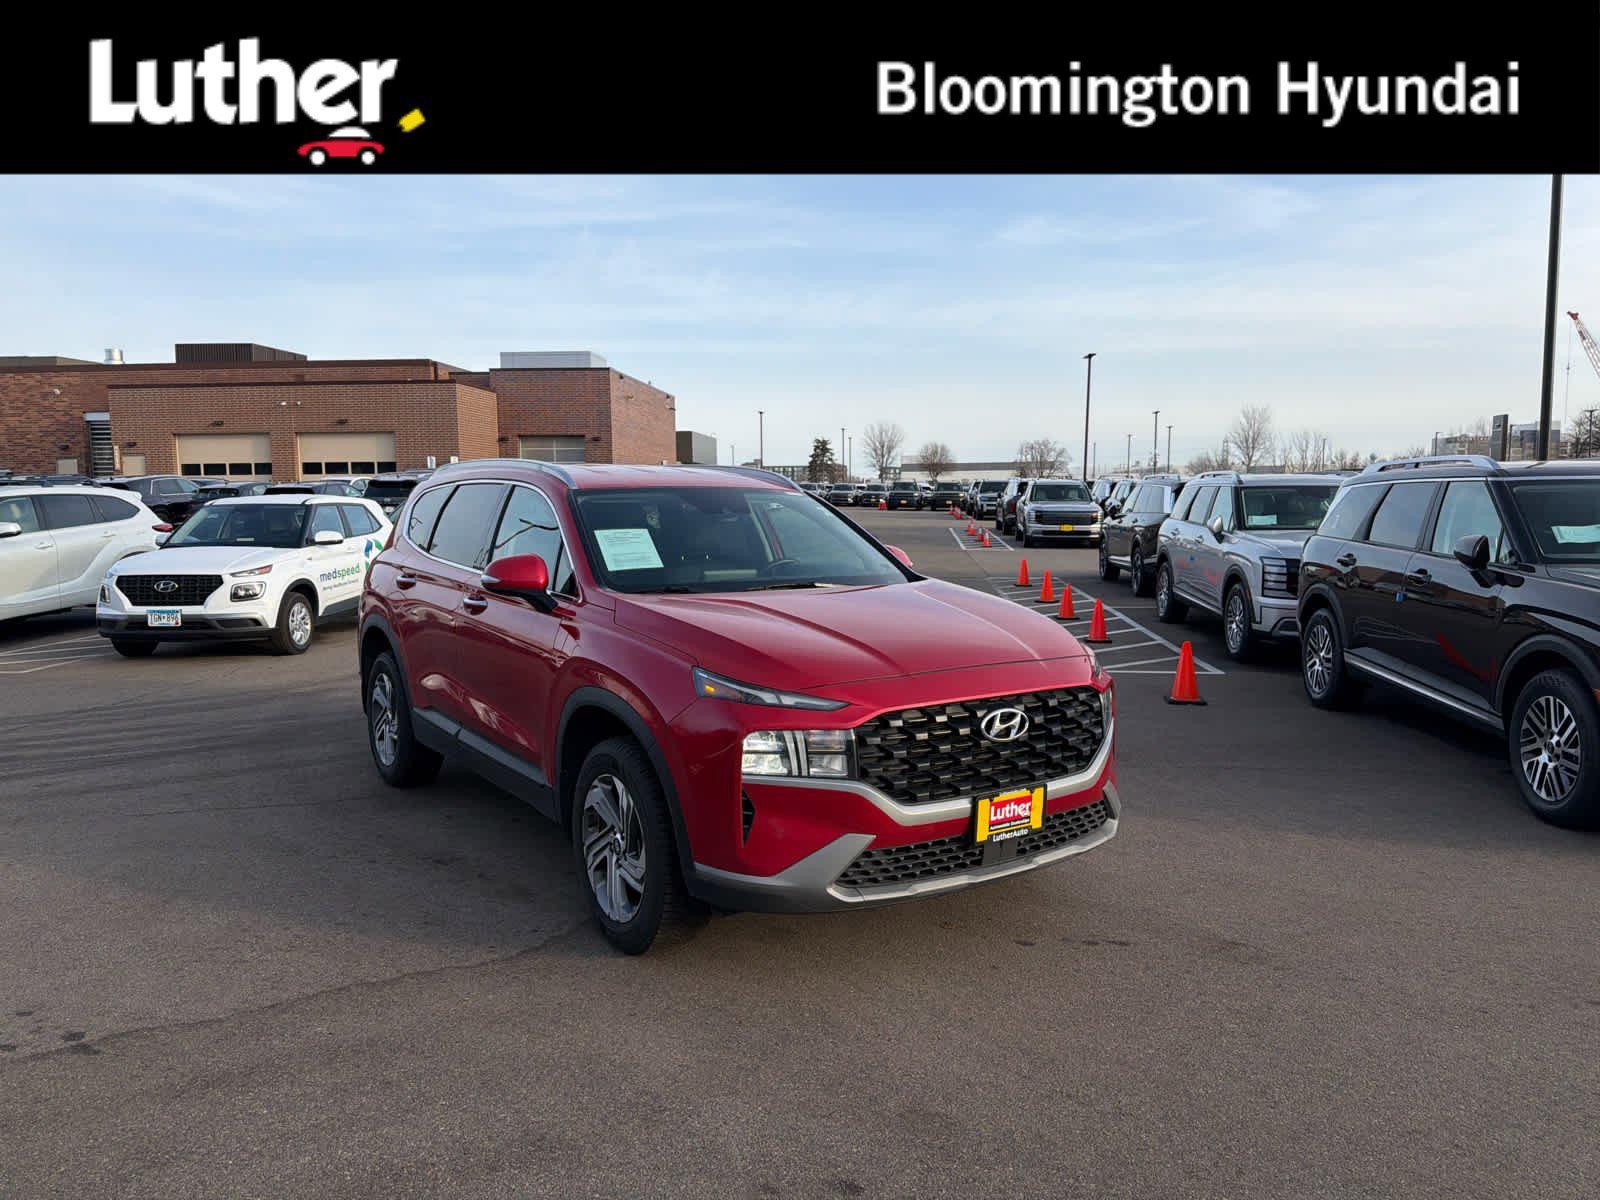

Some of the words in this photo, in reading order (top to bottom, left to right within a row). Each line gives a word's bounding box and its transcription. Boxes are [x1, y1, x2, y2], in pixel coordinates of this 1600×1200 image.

[319, 562, 360, 583] medspeed
[990, 801, 1032, 821] Luther
[992, 828, 1029, 842] LutherAuto
